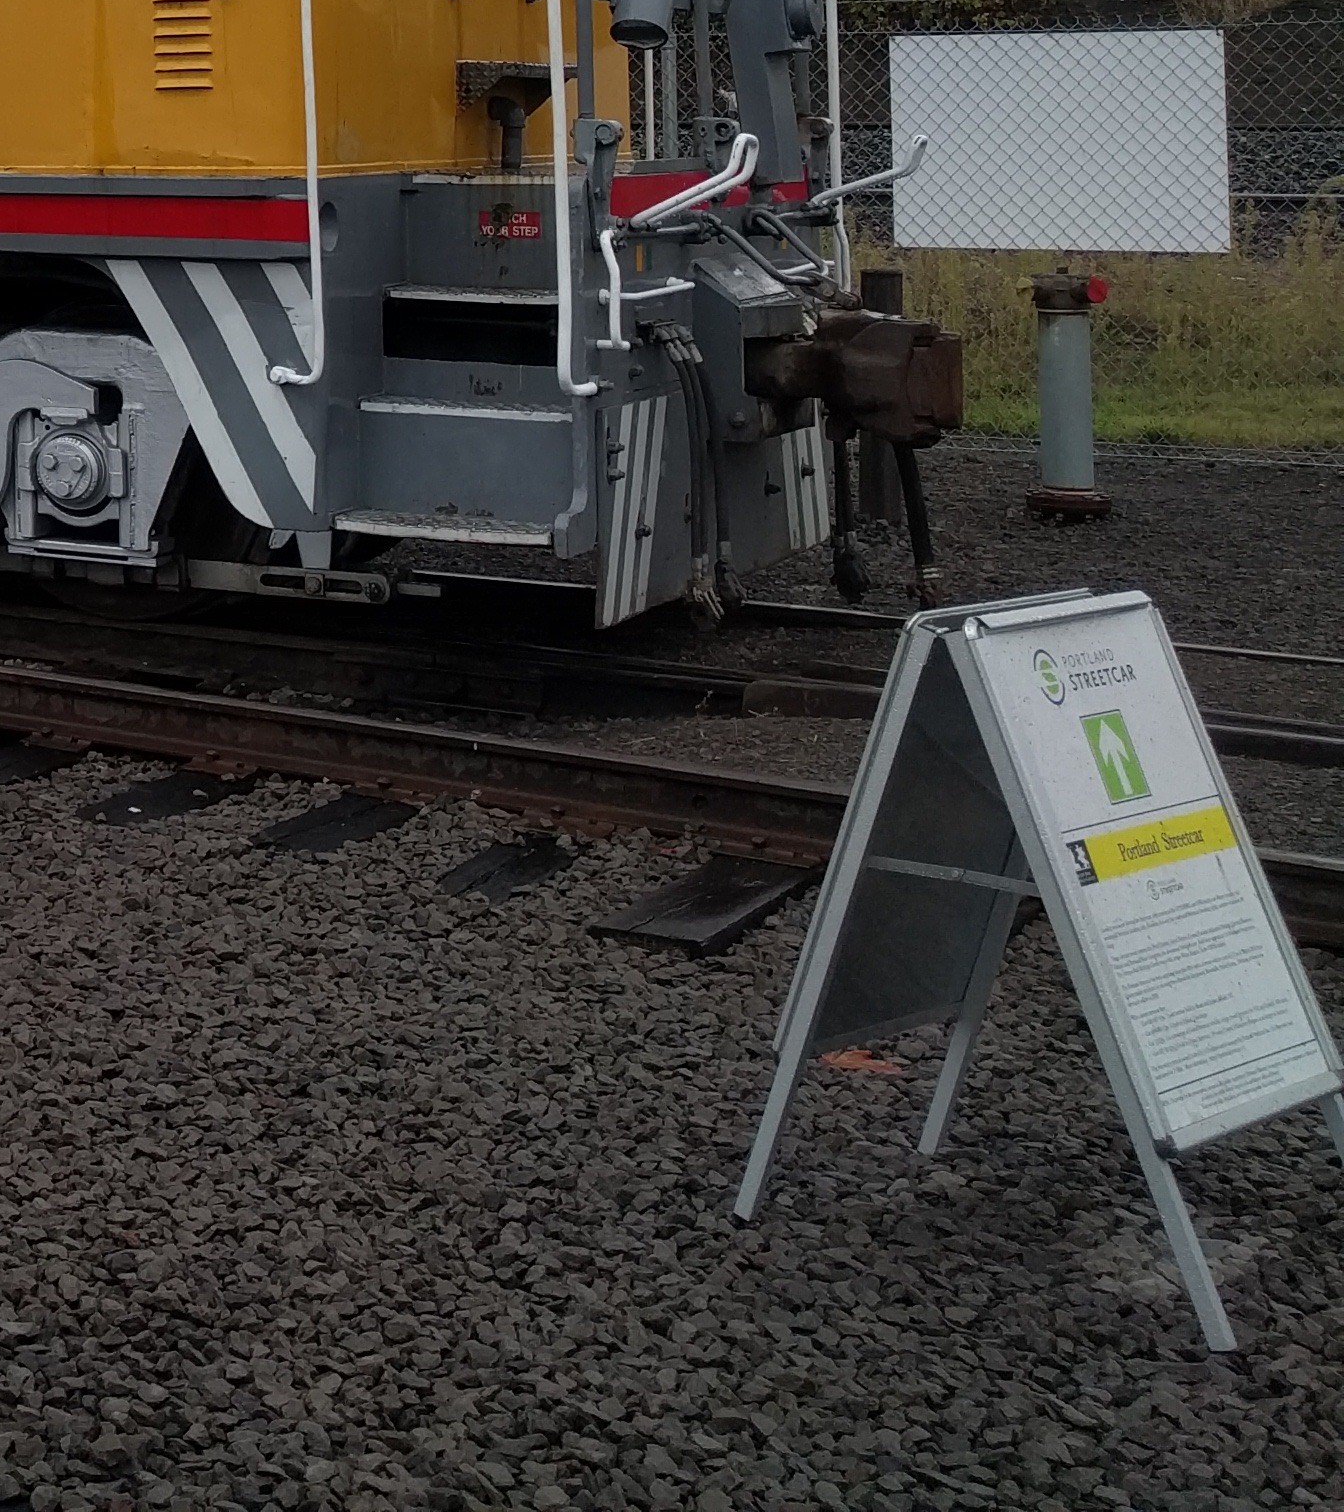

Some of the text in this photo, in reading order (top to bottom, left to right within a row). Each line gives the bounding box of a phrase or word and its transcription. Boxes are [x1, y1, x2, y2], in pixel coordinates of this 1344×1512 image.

[512, 225, 539, 236] STEP
[1061, 648, 1114, 668] PORTLAND
[1068, 664, 1137, 691] STREETCAR
[1117, 829, 1205, 862] Portland Streetcar
